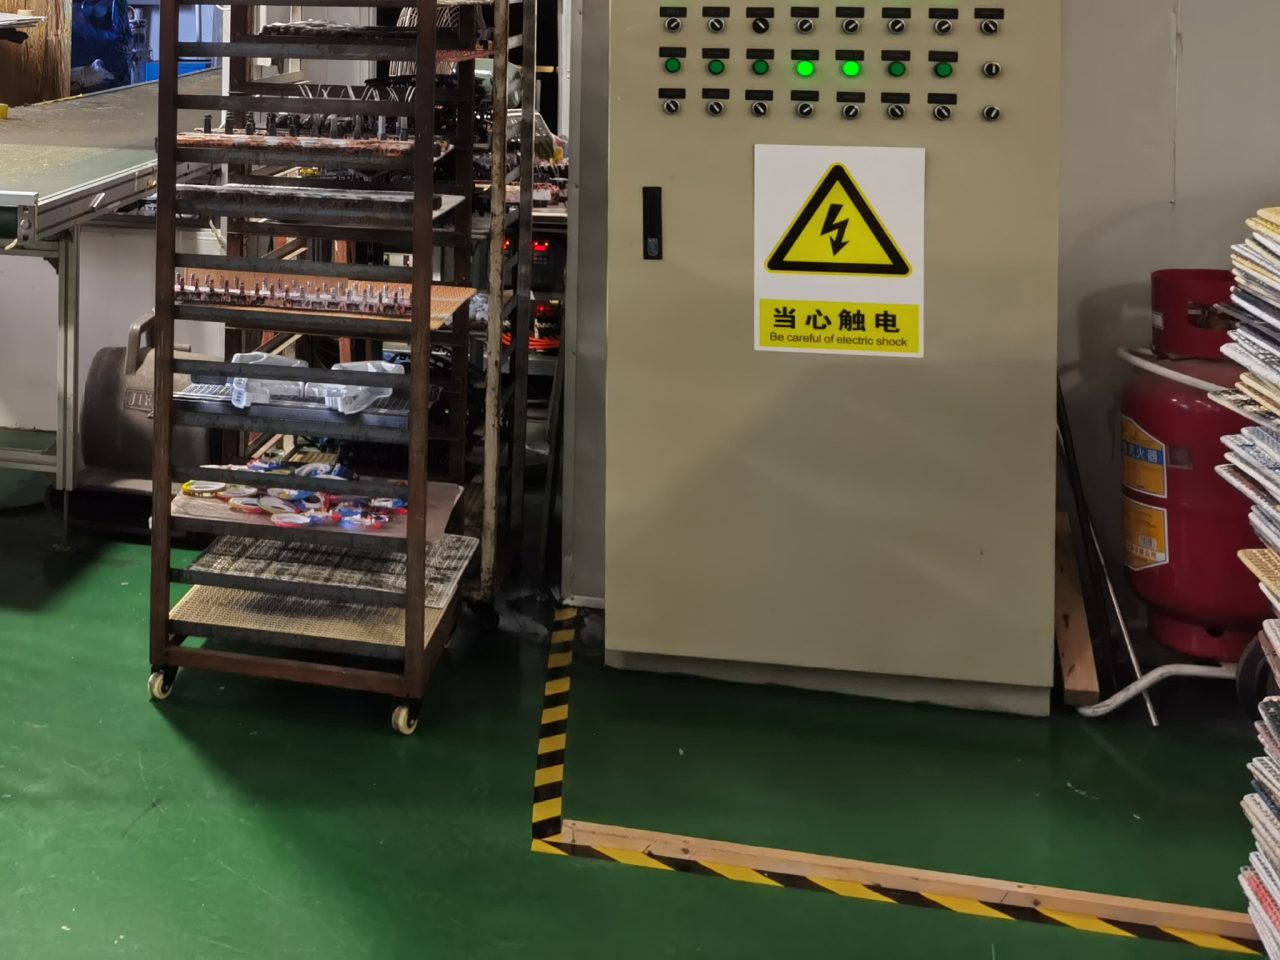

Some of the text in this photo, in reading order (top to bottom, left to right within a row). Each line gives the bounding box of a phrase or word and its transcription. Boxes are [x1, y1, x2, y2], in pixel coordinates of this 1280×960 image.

[773, 306, 900, 333] 当心触电
[769, 331, 908, 347] Be careful of electric shock
